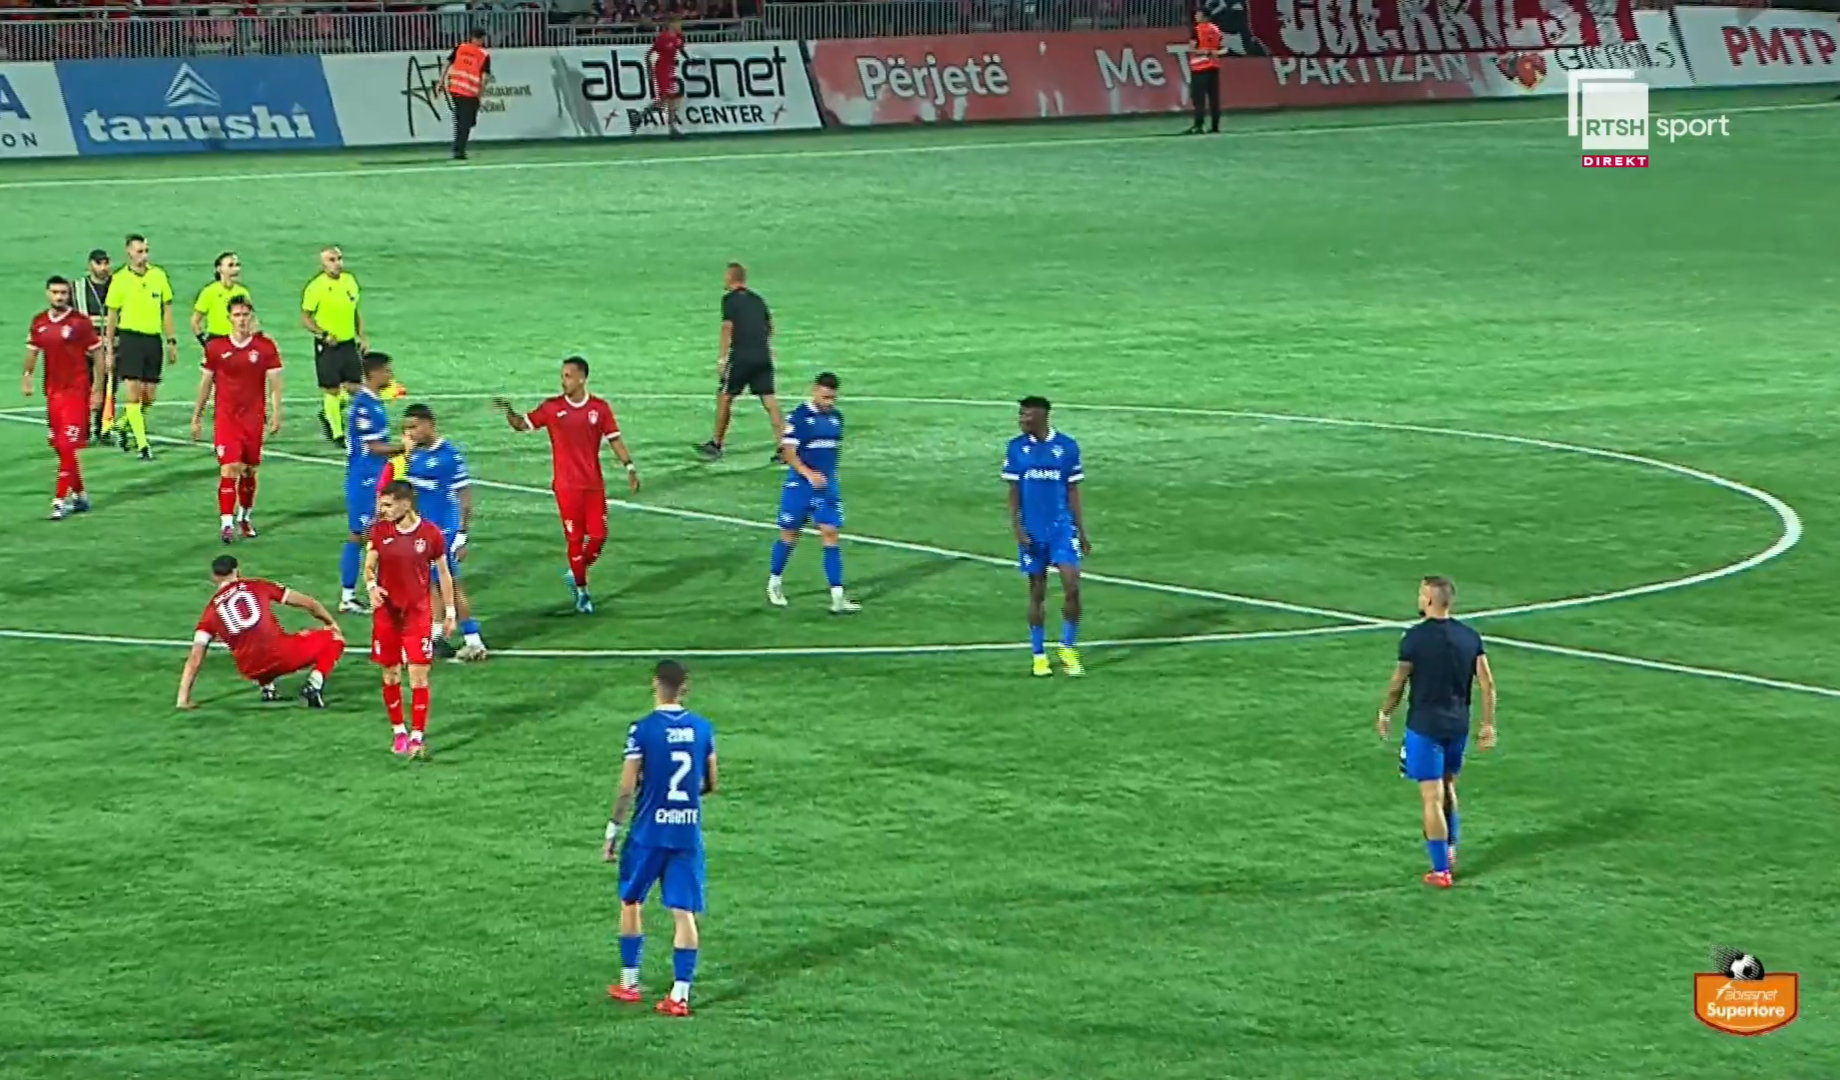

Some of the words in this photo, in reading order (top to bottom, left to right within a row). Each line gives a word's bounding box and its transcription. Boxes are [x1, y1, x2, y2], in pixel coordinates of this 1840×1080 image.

[856, 50, 1010, 106] Përjetë
[1095, 47, 1166, 89] Me
[81, 102, 316, 143] tanushi
[686, 105, 765, 124] CENTER
[215, 591, 262, 635] 10
[667, 751, 692, 801] 2
